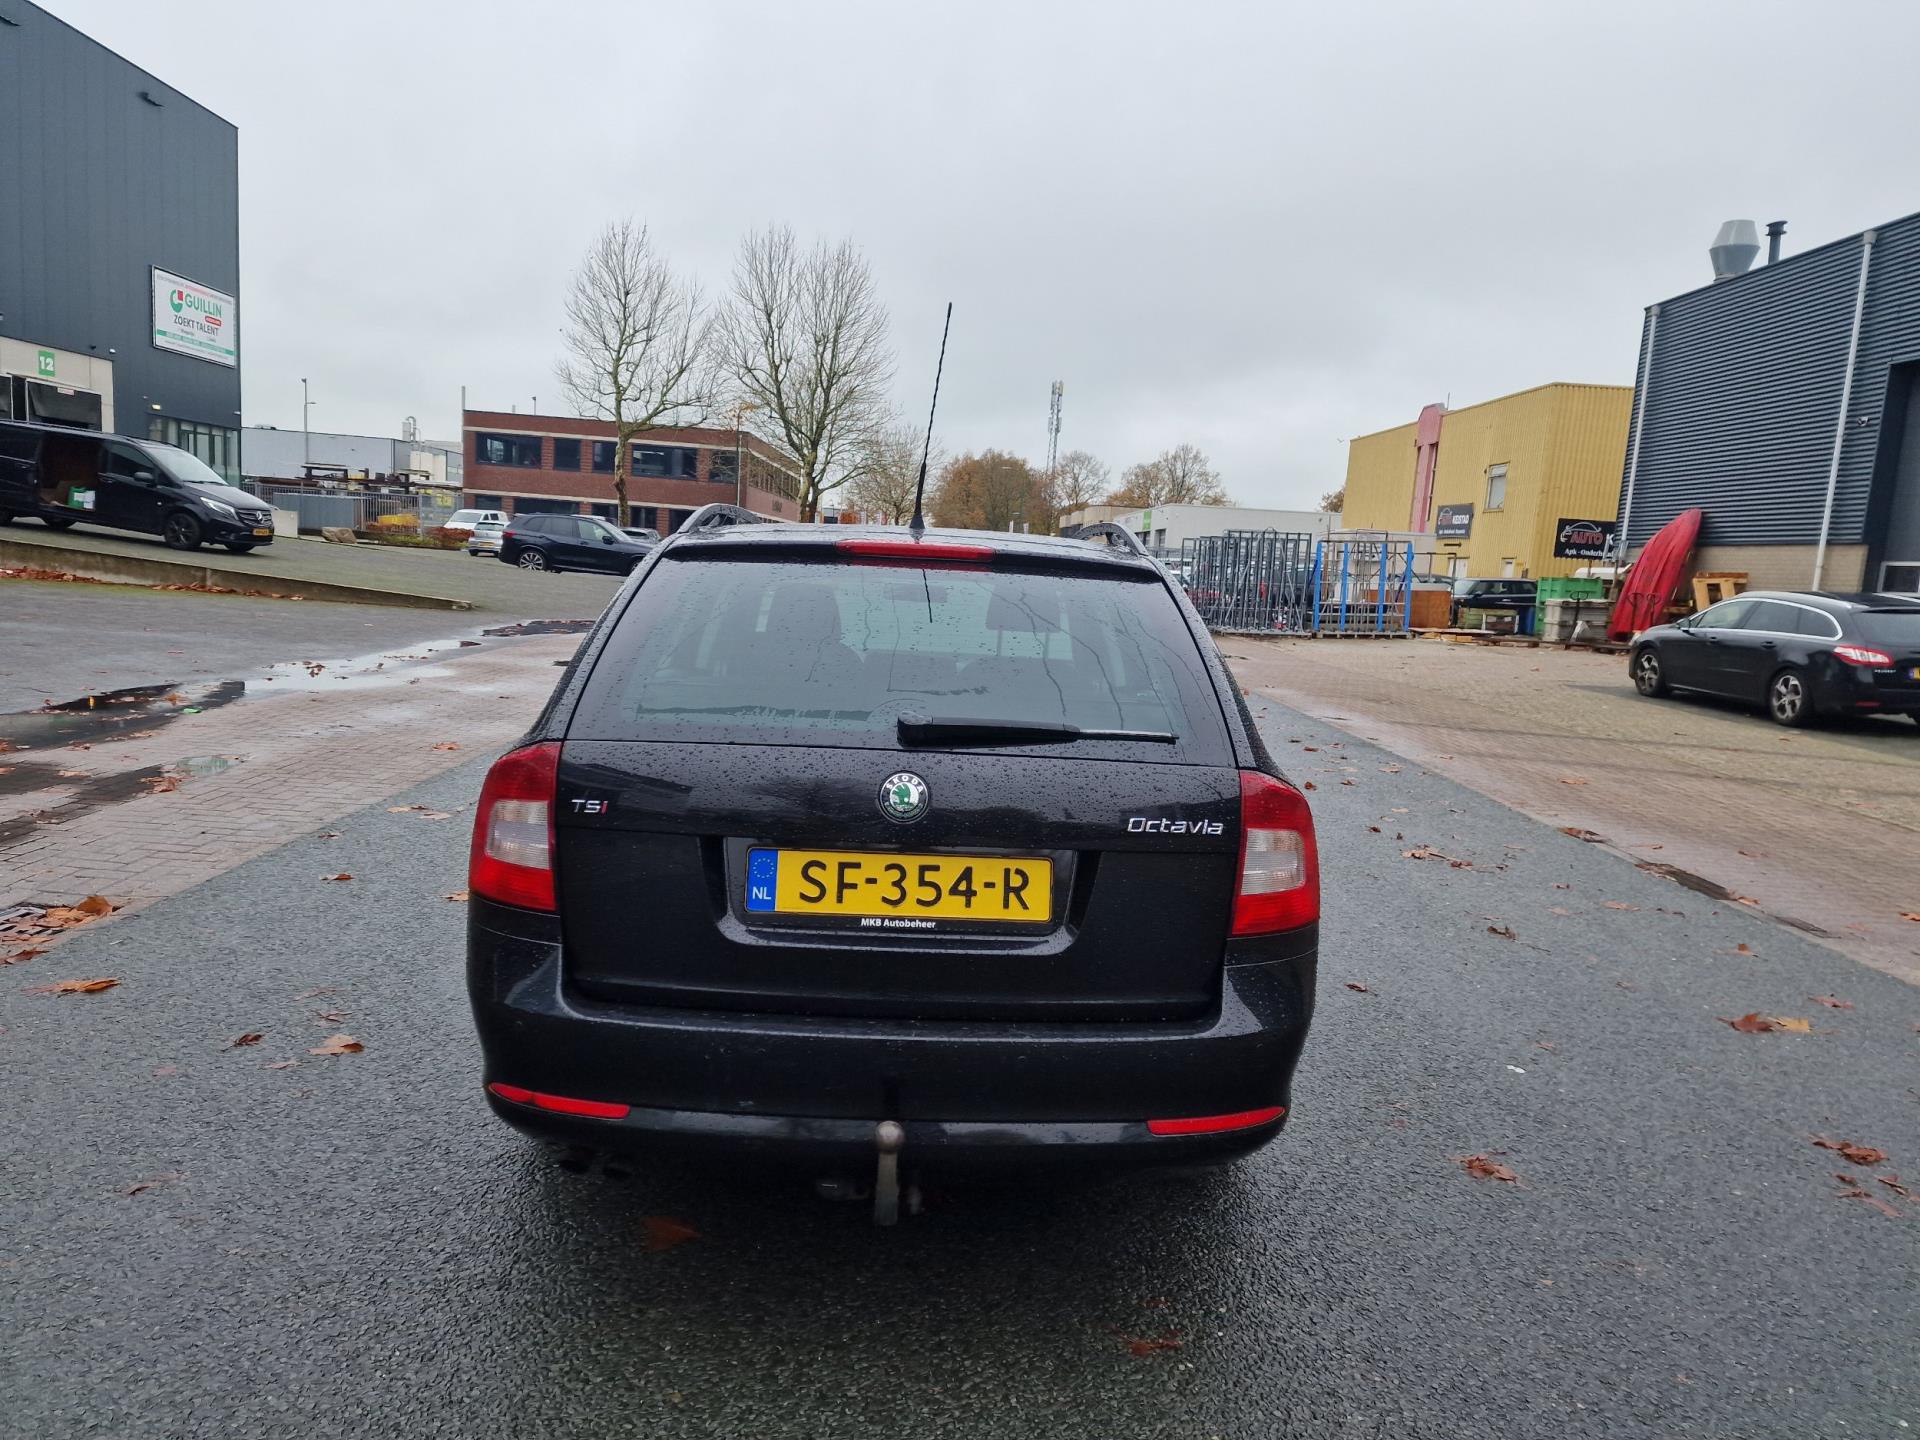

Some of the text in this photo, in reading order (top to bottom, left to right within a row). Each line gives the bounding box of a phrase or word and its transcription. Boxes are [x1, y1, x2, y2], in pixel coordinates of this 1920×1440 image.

[184, 293, 222, 317] GUILLIN
[173, 314, 196, 330] ZOEKT
[196, 321, 219, 337] TALENT
[40, 356, 54, 371] 12
[1570, 532, 1603, 545] AUTO
[1565, 548, 1577, 556] Apk
[1127, 817, 1224, 835] Octavia
[799, 859, 1030, 911] SF-354-R
[751, 886, 772, 901] NL
[860, 917, 936, 929] MKB Autobeheer
